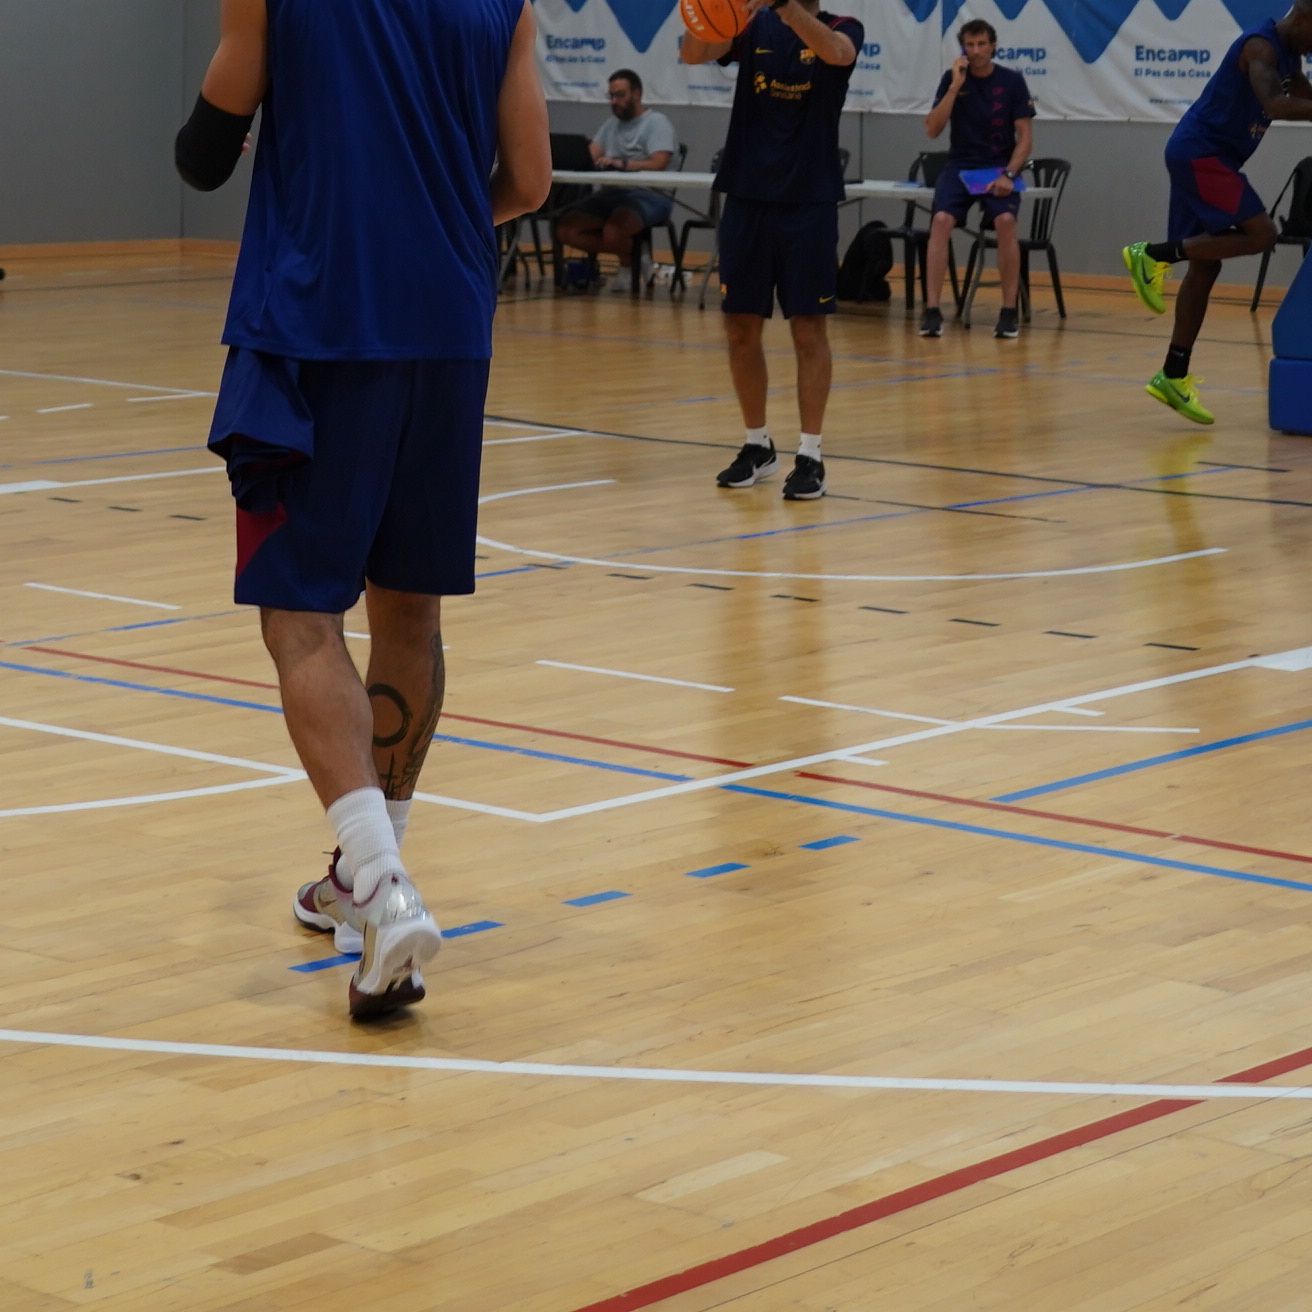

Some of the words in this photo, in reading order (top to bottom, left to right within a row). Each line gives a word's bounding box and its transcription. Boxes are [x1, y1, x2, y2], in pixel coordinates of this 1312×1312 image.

[996, 48, 1046, 62] camp
[1135, 45, 1211, 64] Encamp
[1145, 68, 1161, 78] Pas
[1188, 69, 1211, 78] Casa
